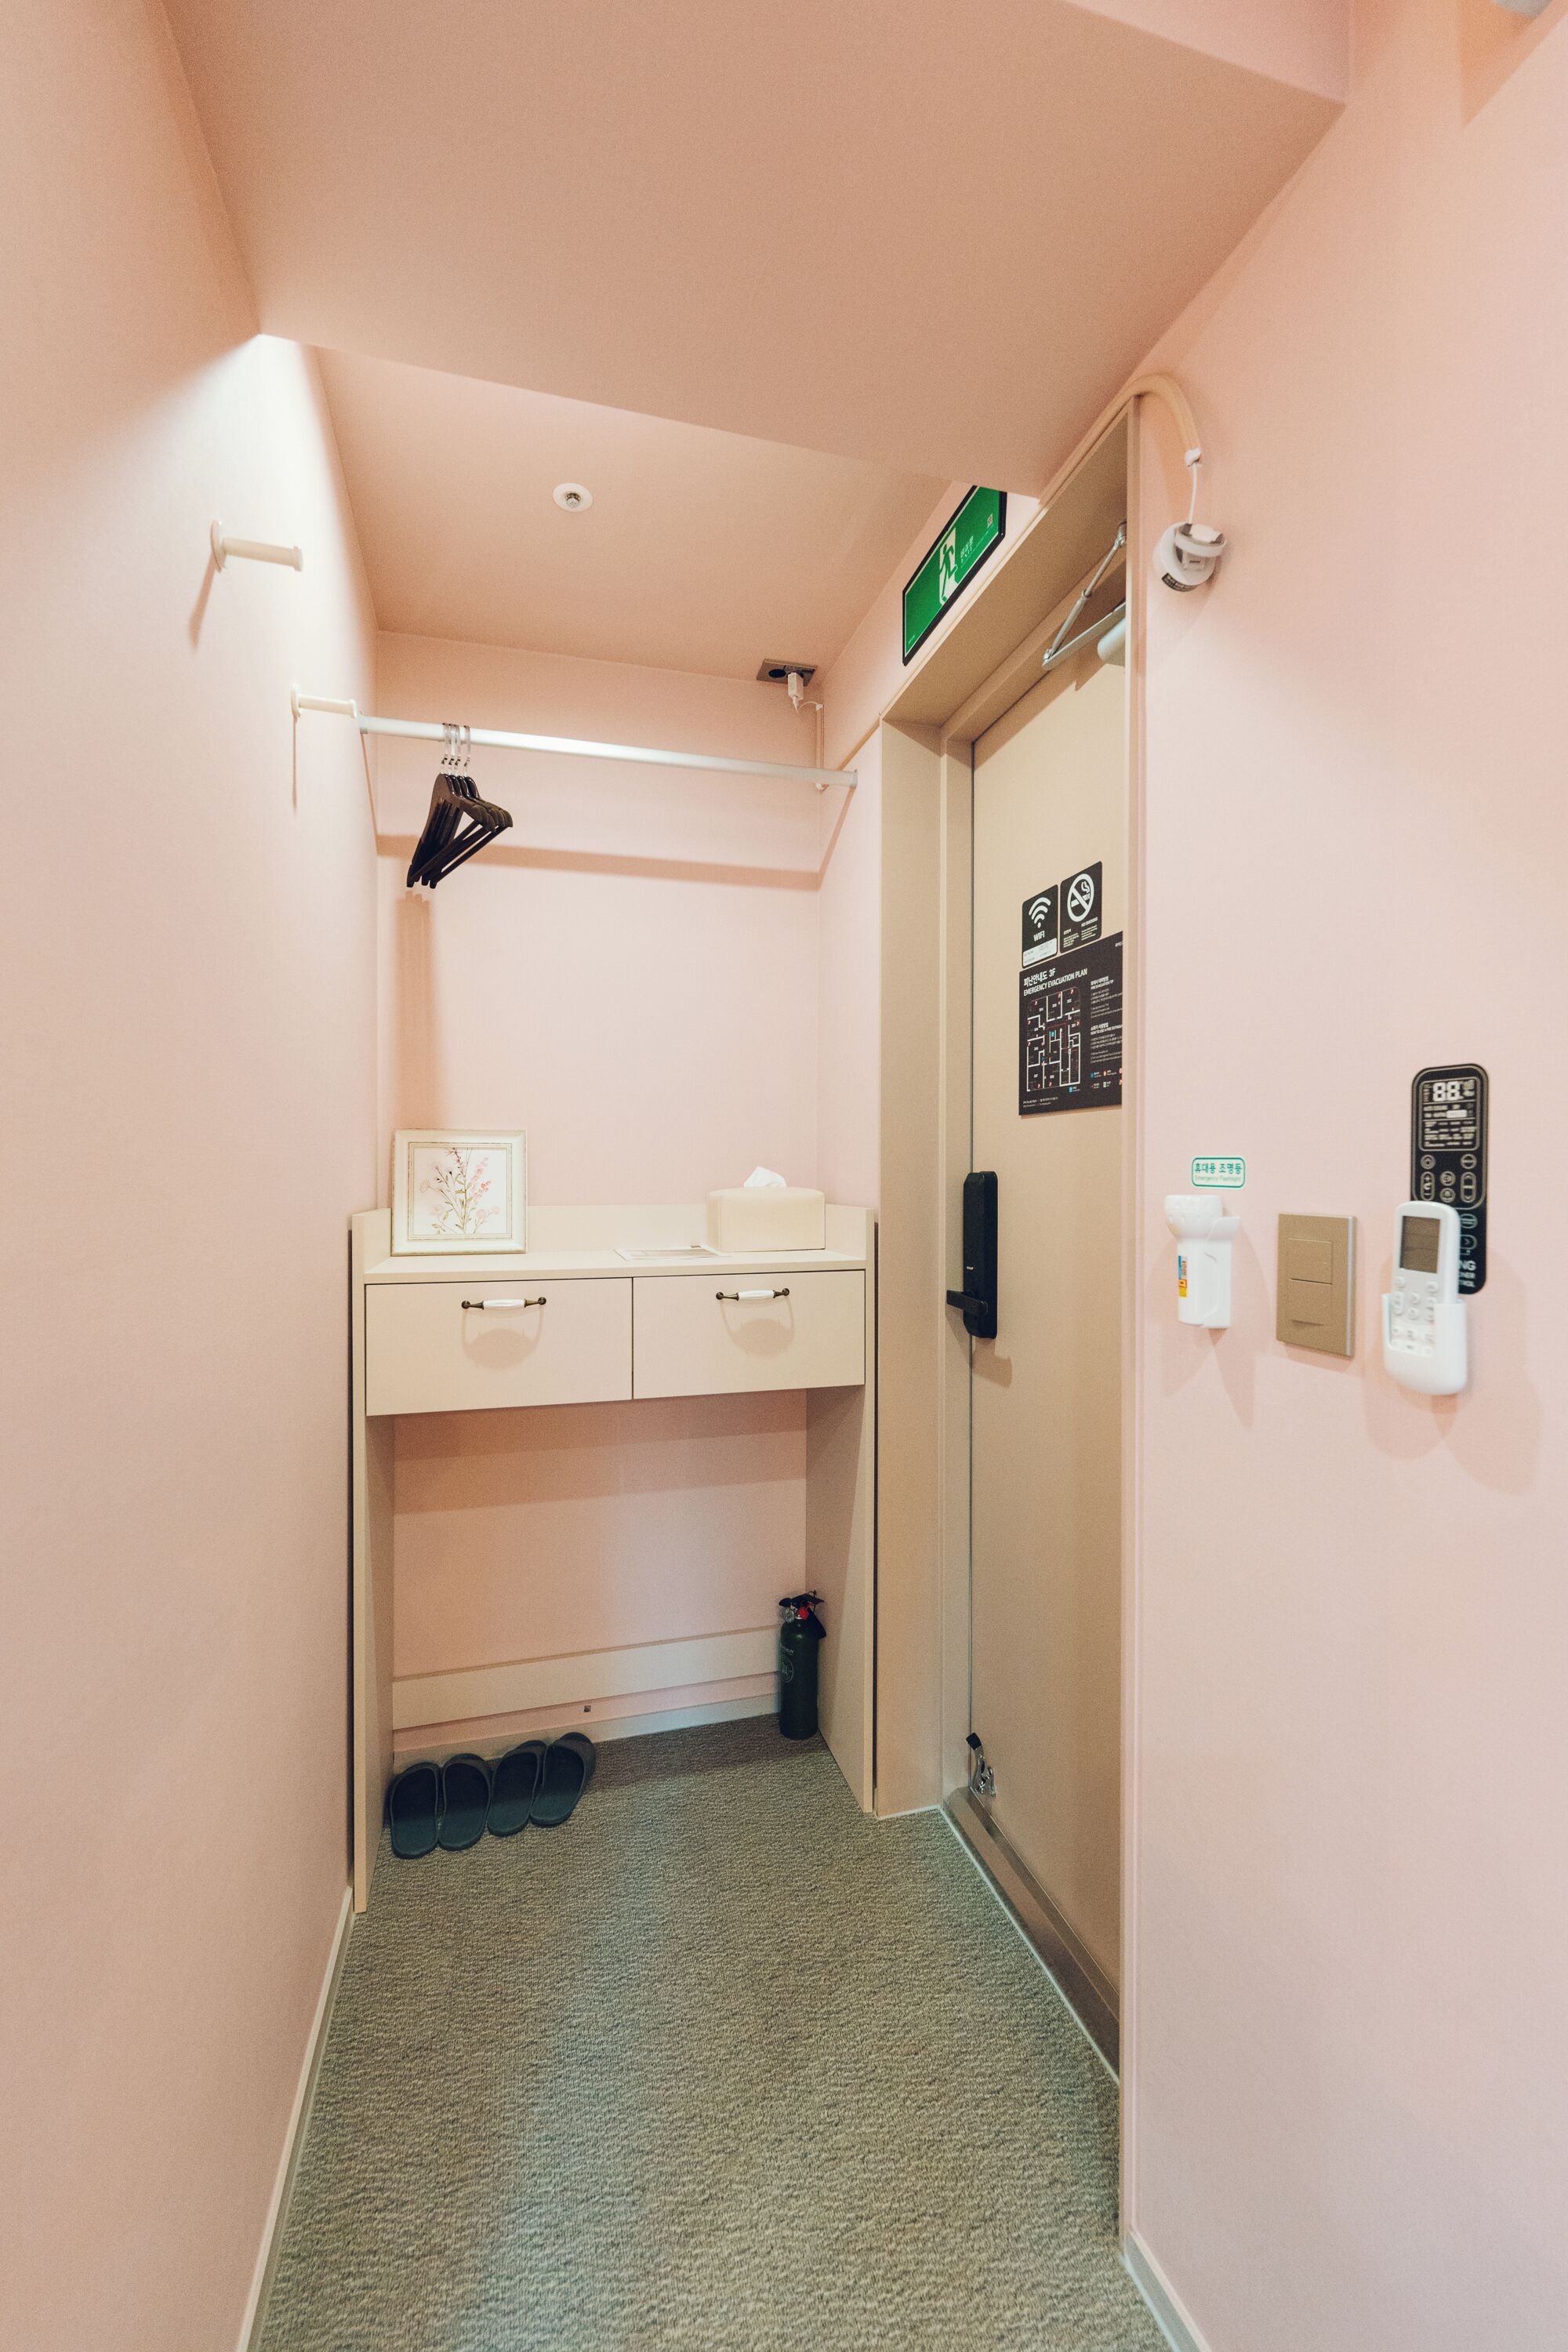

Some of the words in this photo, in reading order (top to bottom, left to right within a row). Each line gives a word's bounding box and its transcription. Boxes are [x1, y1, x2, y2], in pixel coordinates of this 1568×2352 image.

[1033, 930, 1045, 942] WIFI
[1023, 982, 1048, 996] EMERGENCY
[1048, 972, 1075, 988] EVACUATION
[1076, 967, 1088, 979] PLAN
[1194, 1163, 1216, 1174] 휴대용
[1219, 1163, 1242, 1174] 조명등
